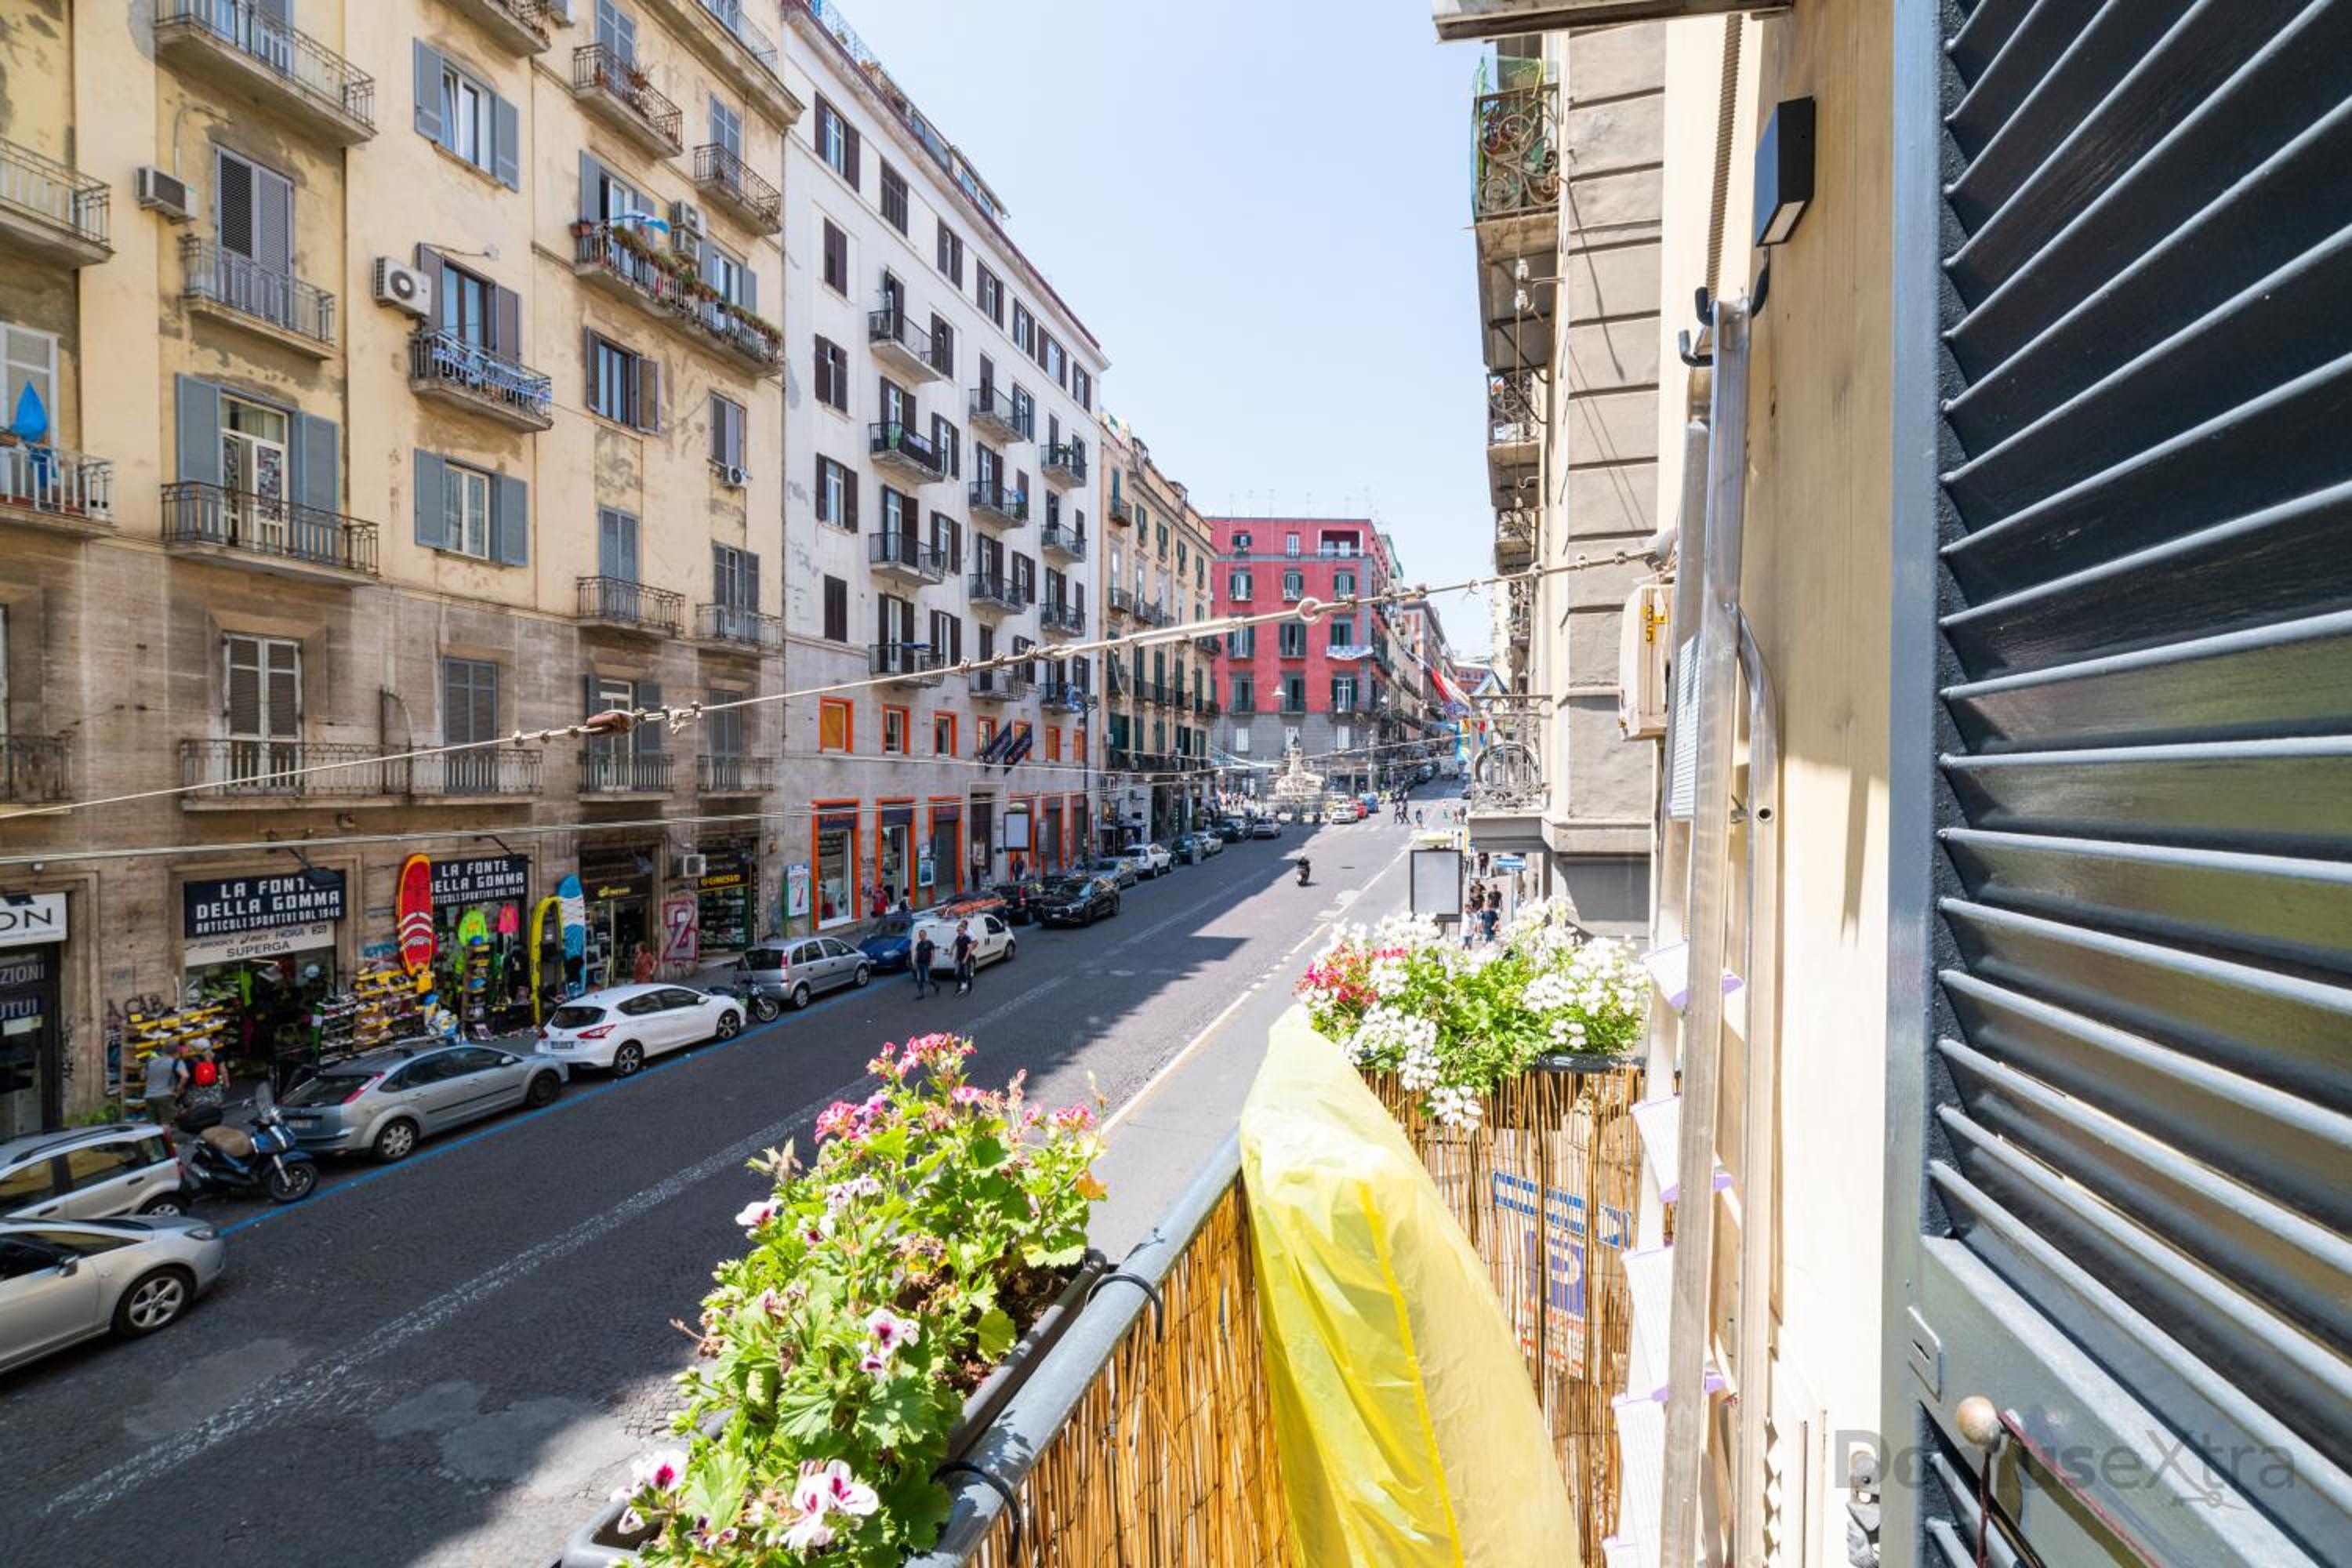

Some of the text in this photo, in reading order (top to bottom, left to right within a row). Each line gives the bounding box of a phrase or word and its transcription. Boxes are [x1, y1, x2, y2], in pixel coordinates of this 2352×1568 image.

[441, 860, 510, 877] LA FONTE
[220, 877, 315, 899] LA FONT
[477, 872, 524, 888] GOMMA
[197, 890, 339, 920] DELLA GOMMA
[196, 916, 247, 934] ARTICOLI
[250, 912, 298, 927] SPORTIVI
[299, 910, 316, 922] DAL
[226, 941, 291, 957] SUPERGA
